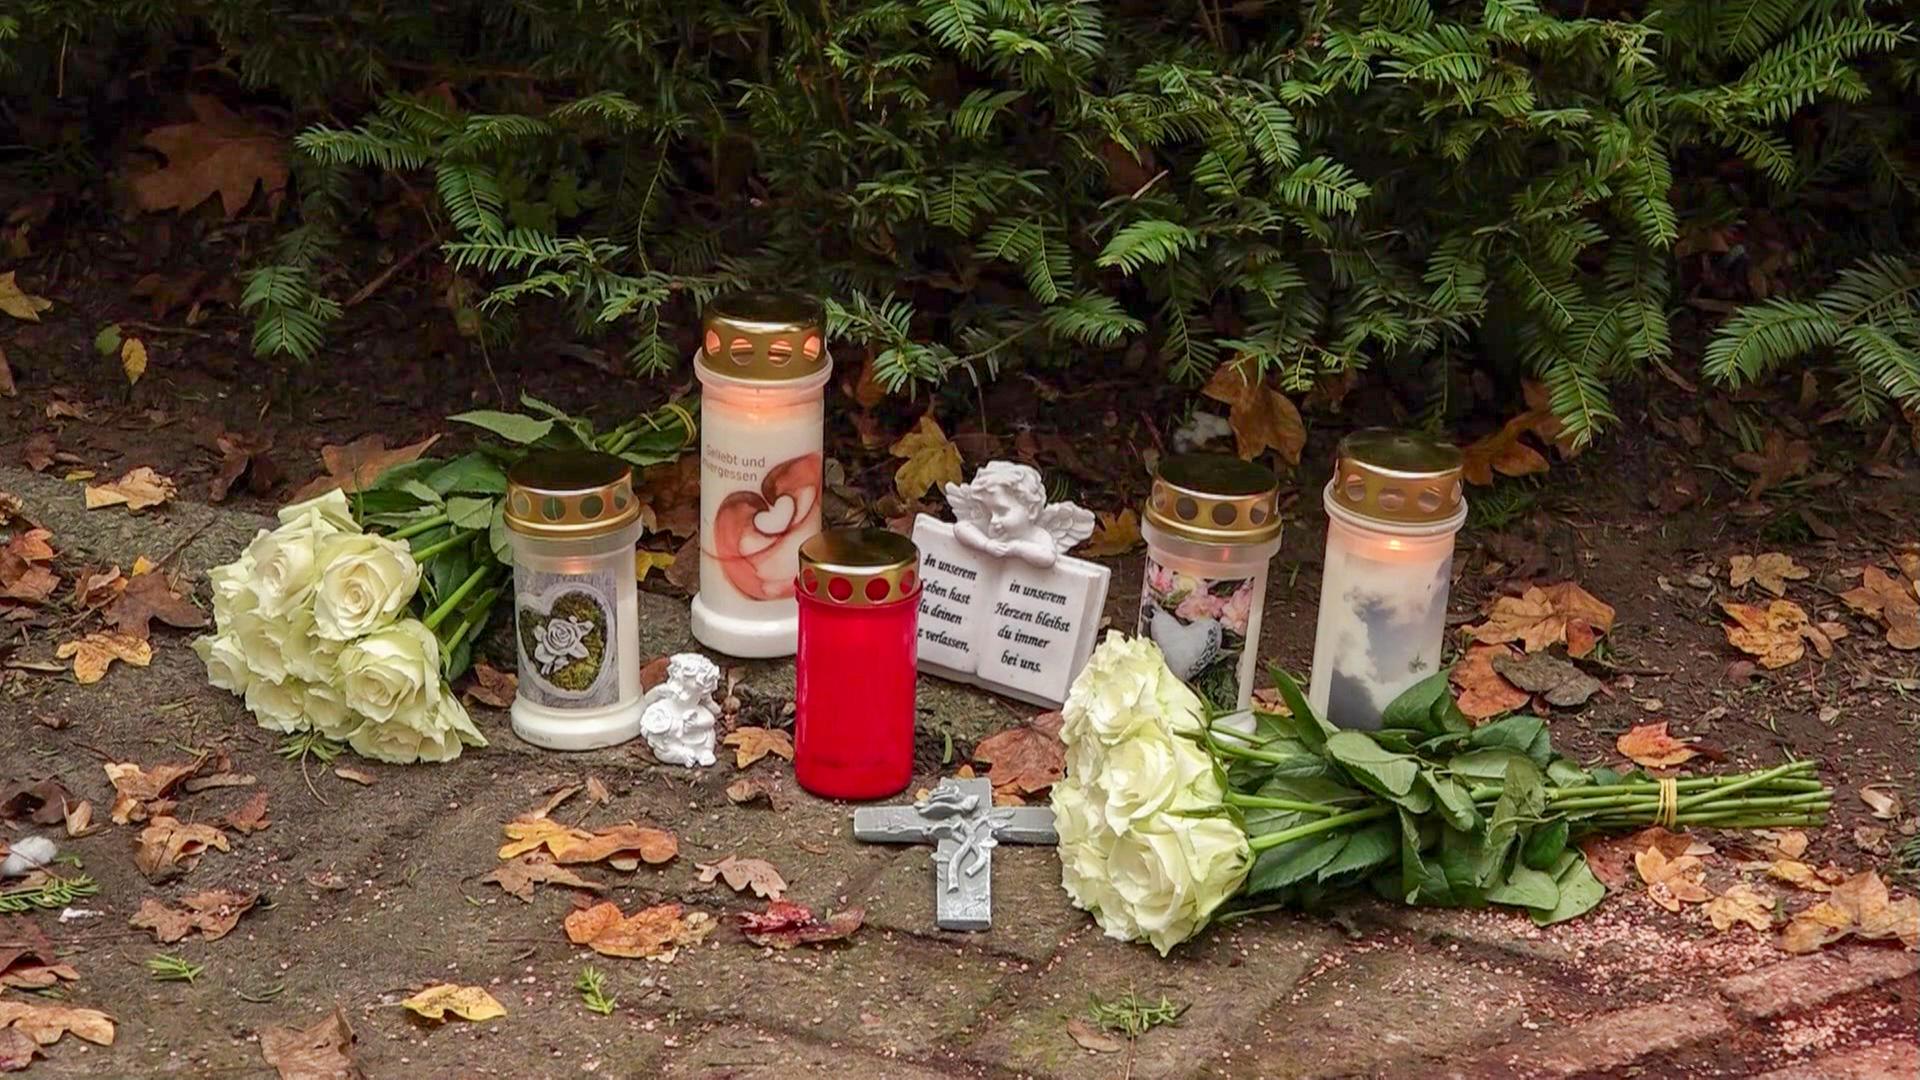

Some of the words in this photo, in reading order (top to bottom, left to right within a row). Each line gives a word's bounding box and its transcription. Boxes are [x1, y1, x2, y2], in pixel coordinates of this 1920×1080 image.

[742, 456, 766, 468] und
[924, 553, 936, 568] In
[938, 560, 977, 580] unserem
[948, 586, 971, 605] hast
[1009, 579, 1021, 594] in
[1022, 586, 1067, 605] unserem
[930, 604, 962, 624] deinen
[994, 601, 1033, 622] Herzen
[1035, 611, 1071, 632] bleibst
[926, 630, 970, 653] verlassen,
[997, 624, 1012, 640] du
[1014, 628, 1051, 649] immer
[1001, 649, 1019, 666] bei
[1020, 658, 1042, 673] uns.
